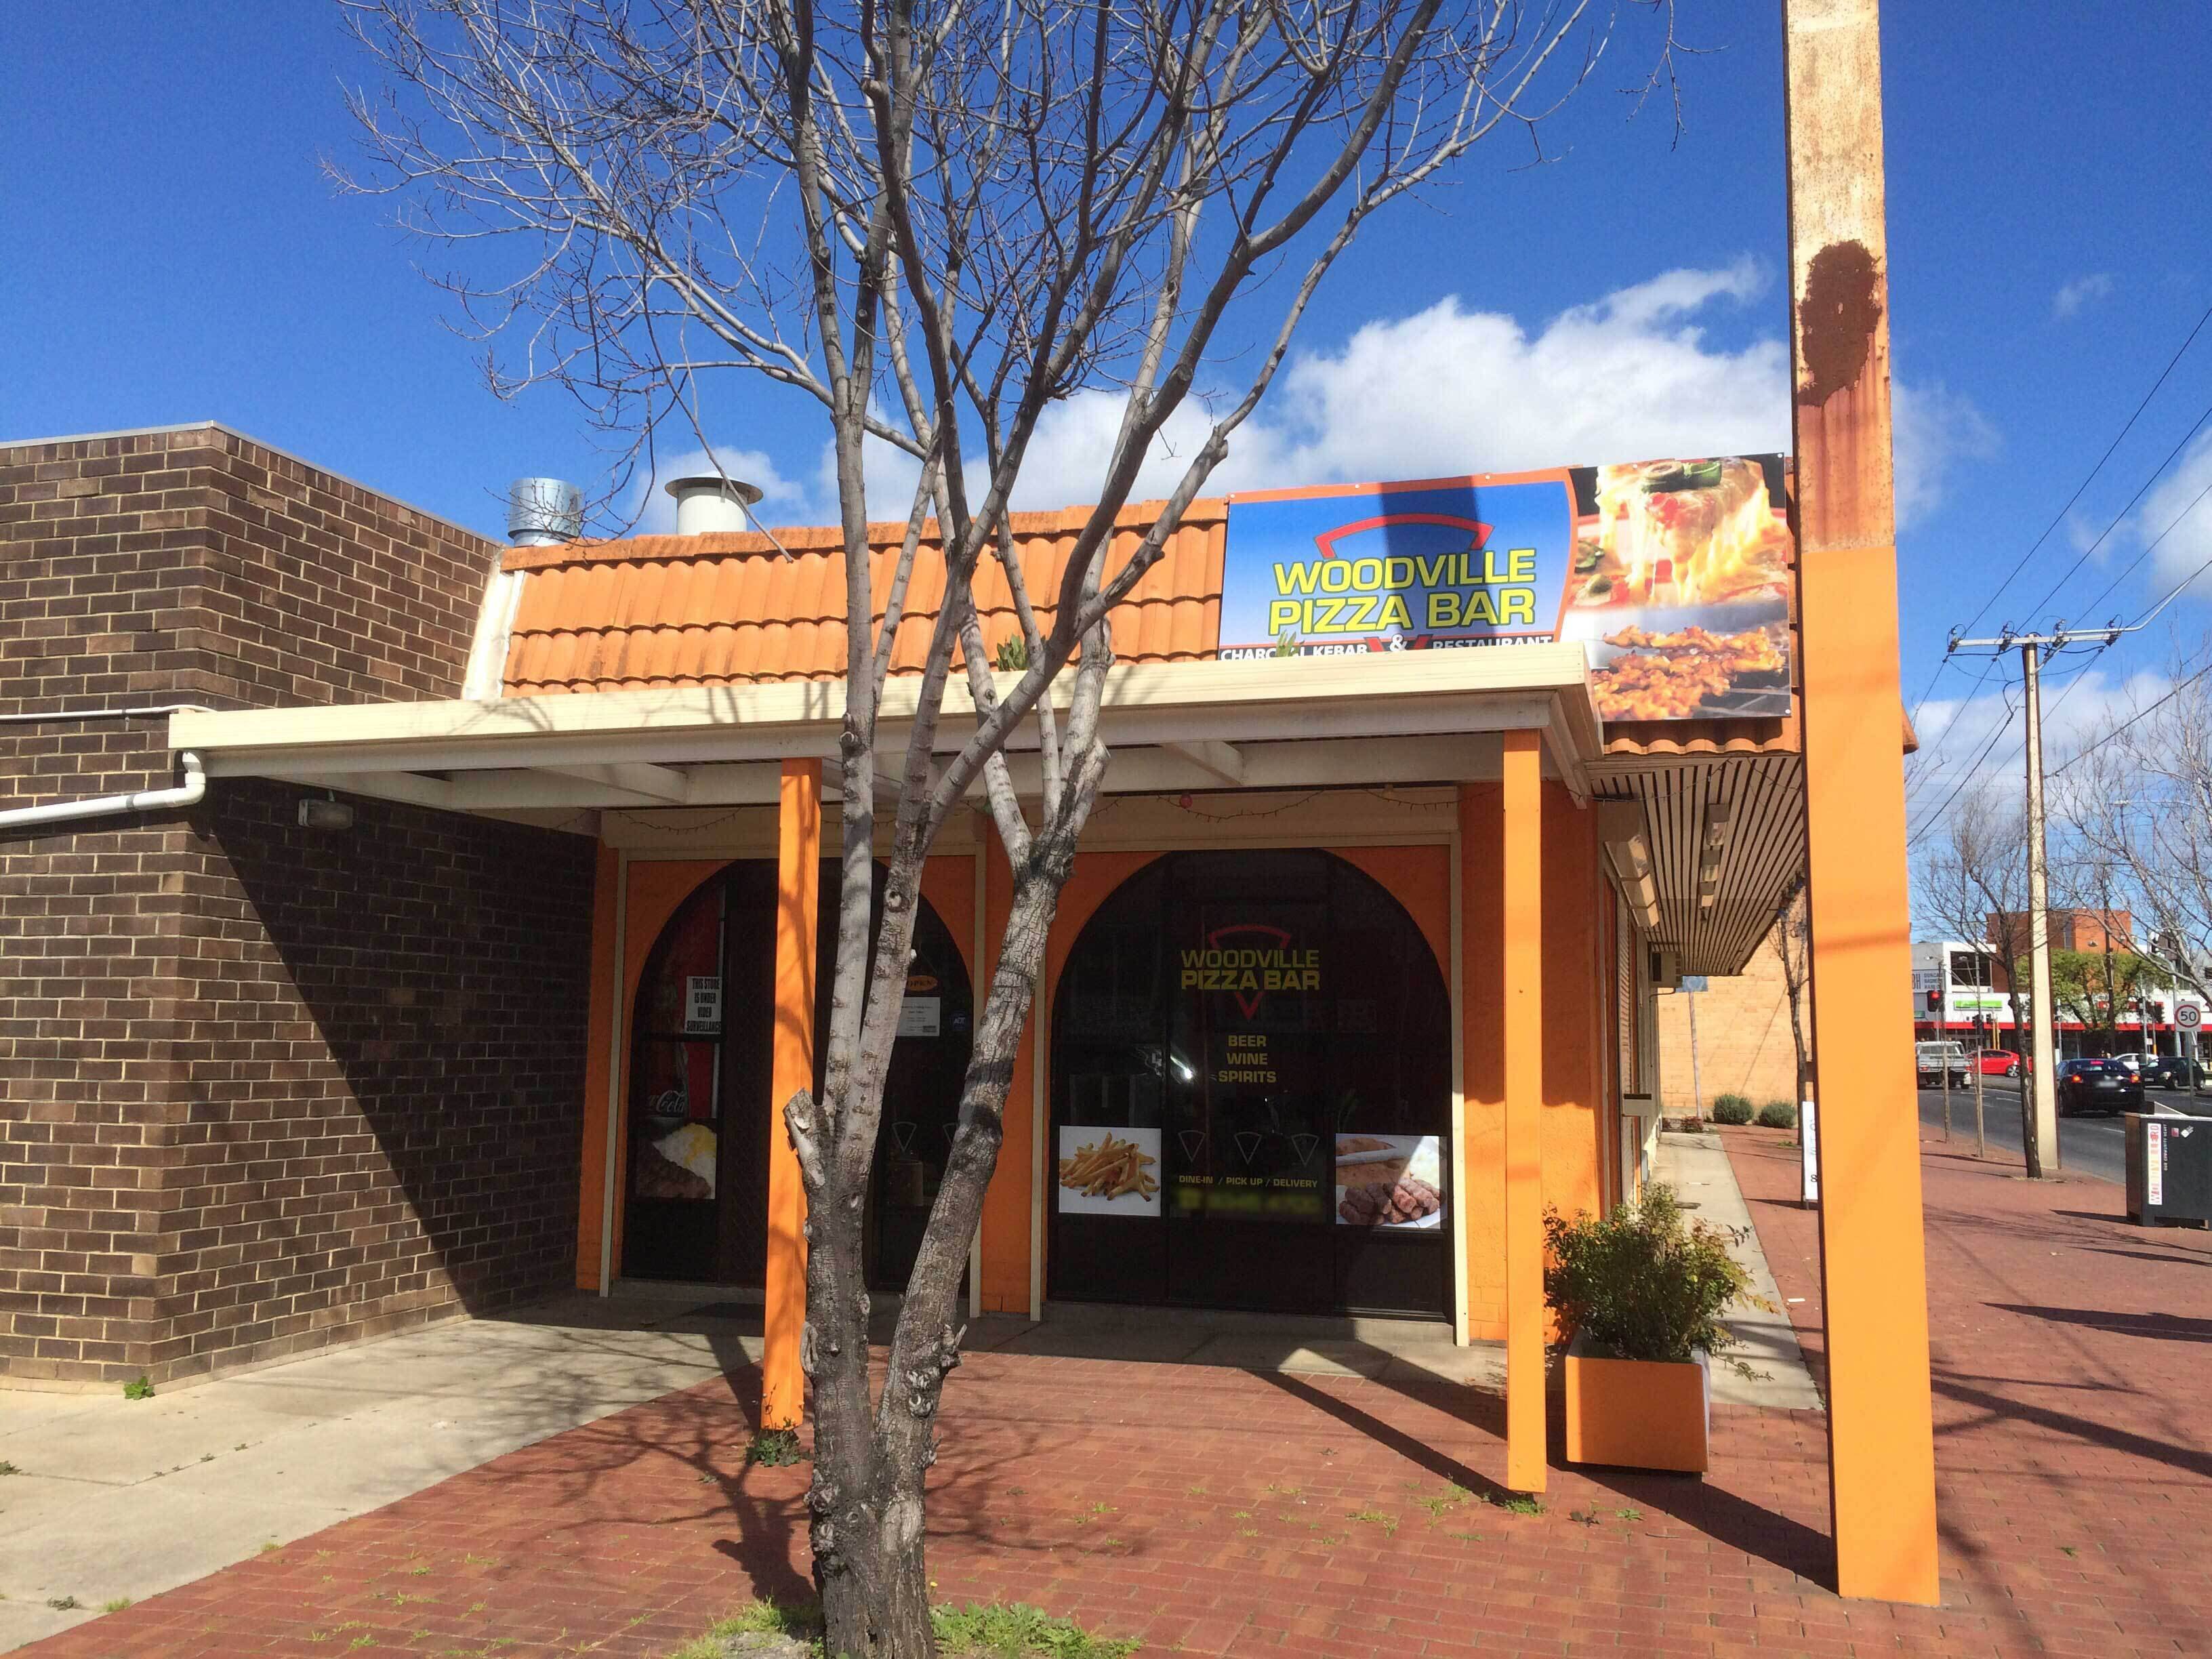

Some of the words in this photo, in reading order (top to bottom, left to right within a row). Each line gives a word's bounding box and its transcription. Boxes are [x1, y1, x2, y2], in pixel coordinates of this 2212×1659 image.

[1274, 548, 1536, 596] WOODVILLE
[1269, 593, 1413, 636] PIZZA
[1426, 588, 1536, 629] BAR
[1221, 647, 1305, 661] CHARCL
[1181, 949, 1319, 969] WOODVILLE
[693, 978, 703, 989] THIS
[705, 978, 720, 989] STORE
[1181, 970, 1258, 990] PIZZA
[1264, 970, 1320, 990] BAR
[694, 991, 699, 1003] IS
[701, 992, 716, 1004] UNDER
[697, 1006, 712, 1018] VIDEO
[2180, 1010, 2197, 1021] 50
[687, 1020, 721, 1031] SURVEILLANCE
[1228, 1035, 1267, 1048] BEER
[1227, 1052, 1268, 1065] WINE
[1218, 1070, 1277, 1083] SPIRITS
[1179, 1174, 1214, 1185] DINE-IN
[1226, 1176, 1248, 1186] PICK
[1250, 1176, 1263, 1187] UP
[1273, 1177, 1318, 1188] DELIVERY
